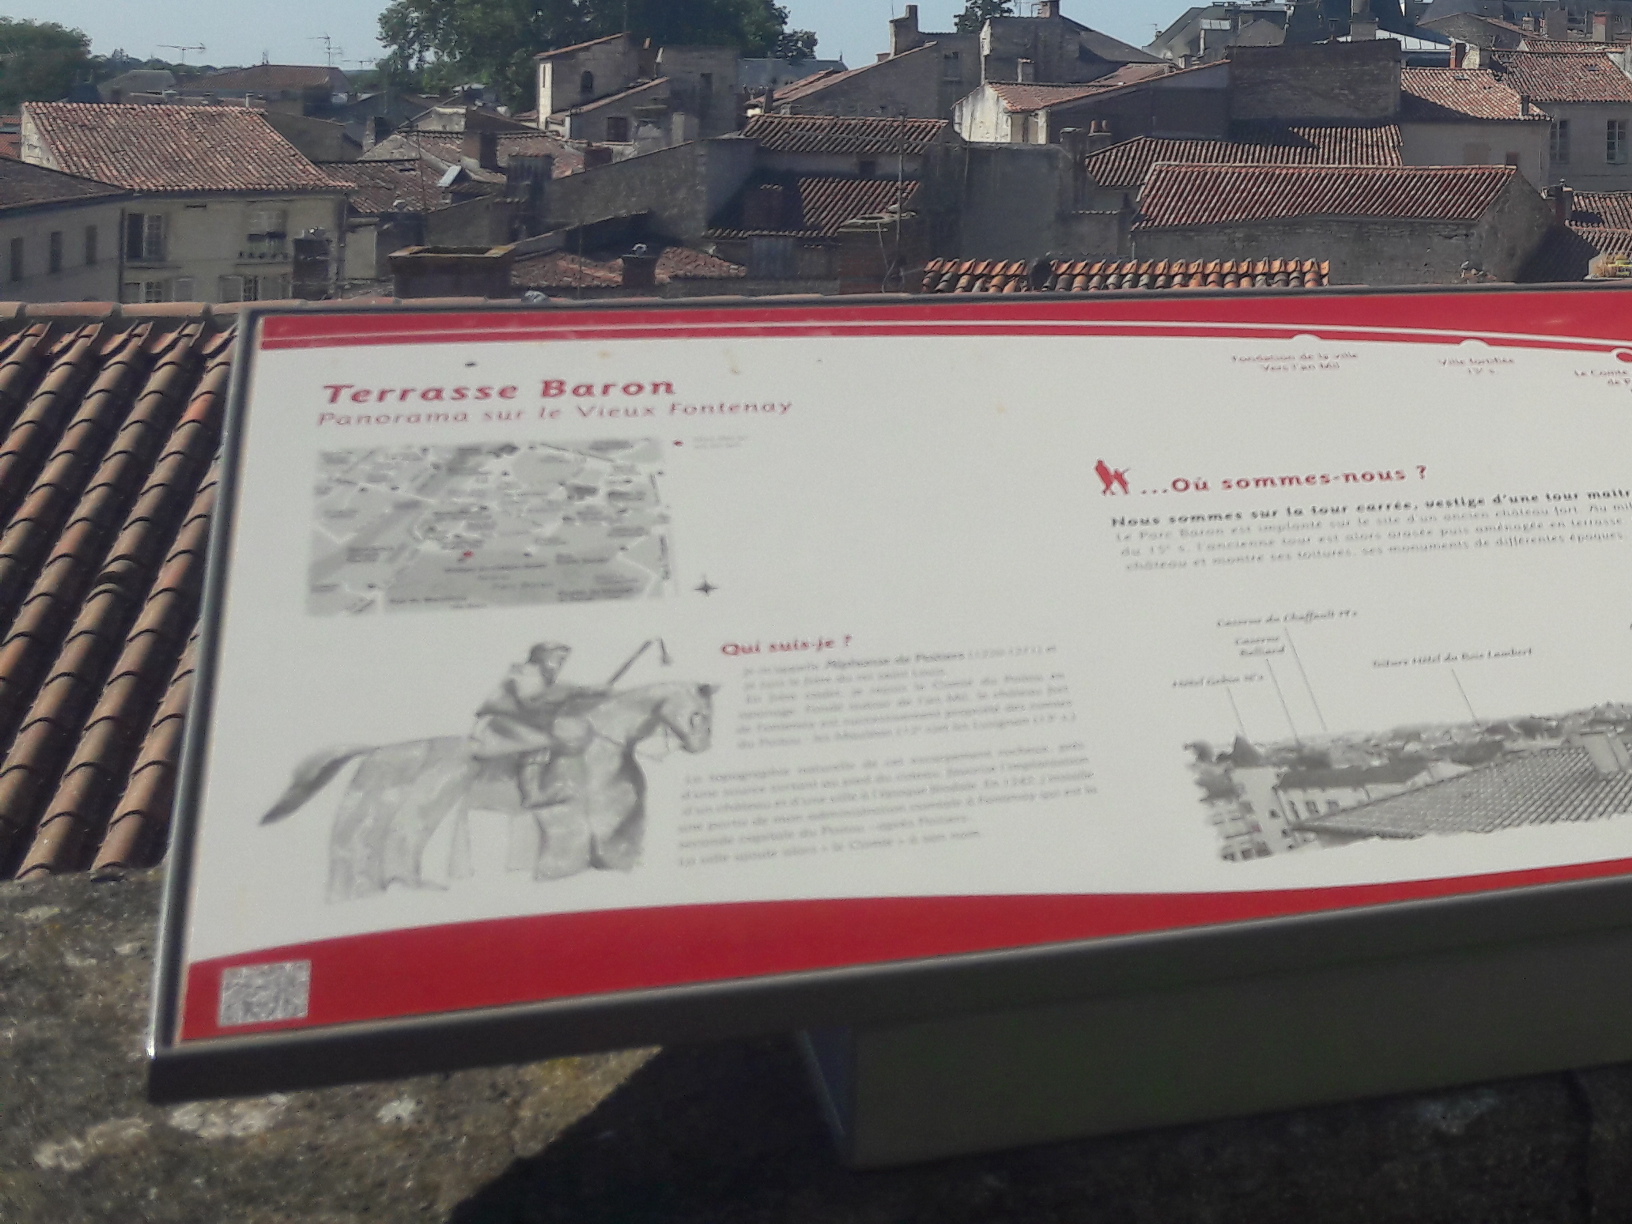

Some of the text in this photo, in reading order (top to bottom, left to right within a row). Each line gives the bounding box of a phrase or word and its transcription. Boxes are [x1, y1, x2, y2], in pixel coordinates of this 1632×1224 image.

[323, 379, 676, 403] Terrasse Baron
[319, 401, 793, 425] Panorama sur le Vieux Fontenay
[1221, 468, 1407, 491] sommes-nous
[1112, 516, 1160, 527] Nous
[1169, 512, 1242, 523] sommes
[721, 641, 761, 656] Qui
[769, 636, 834, 653] suis-je
